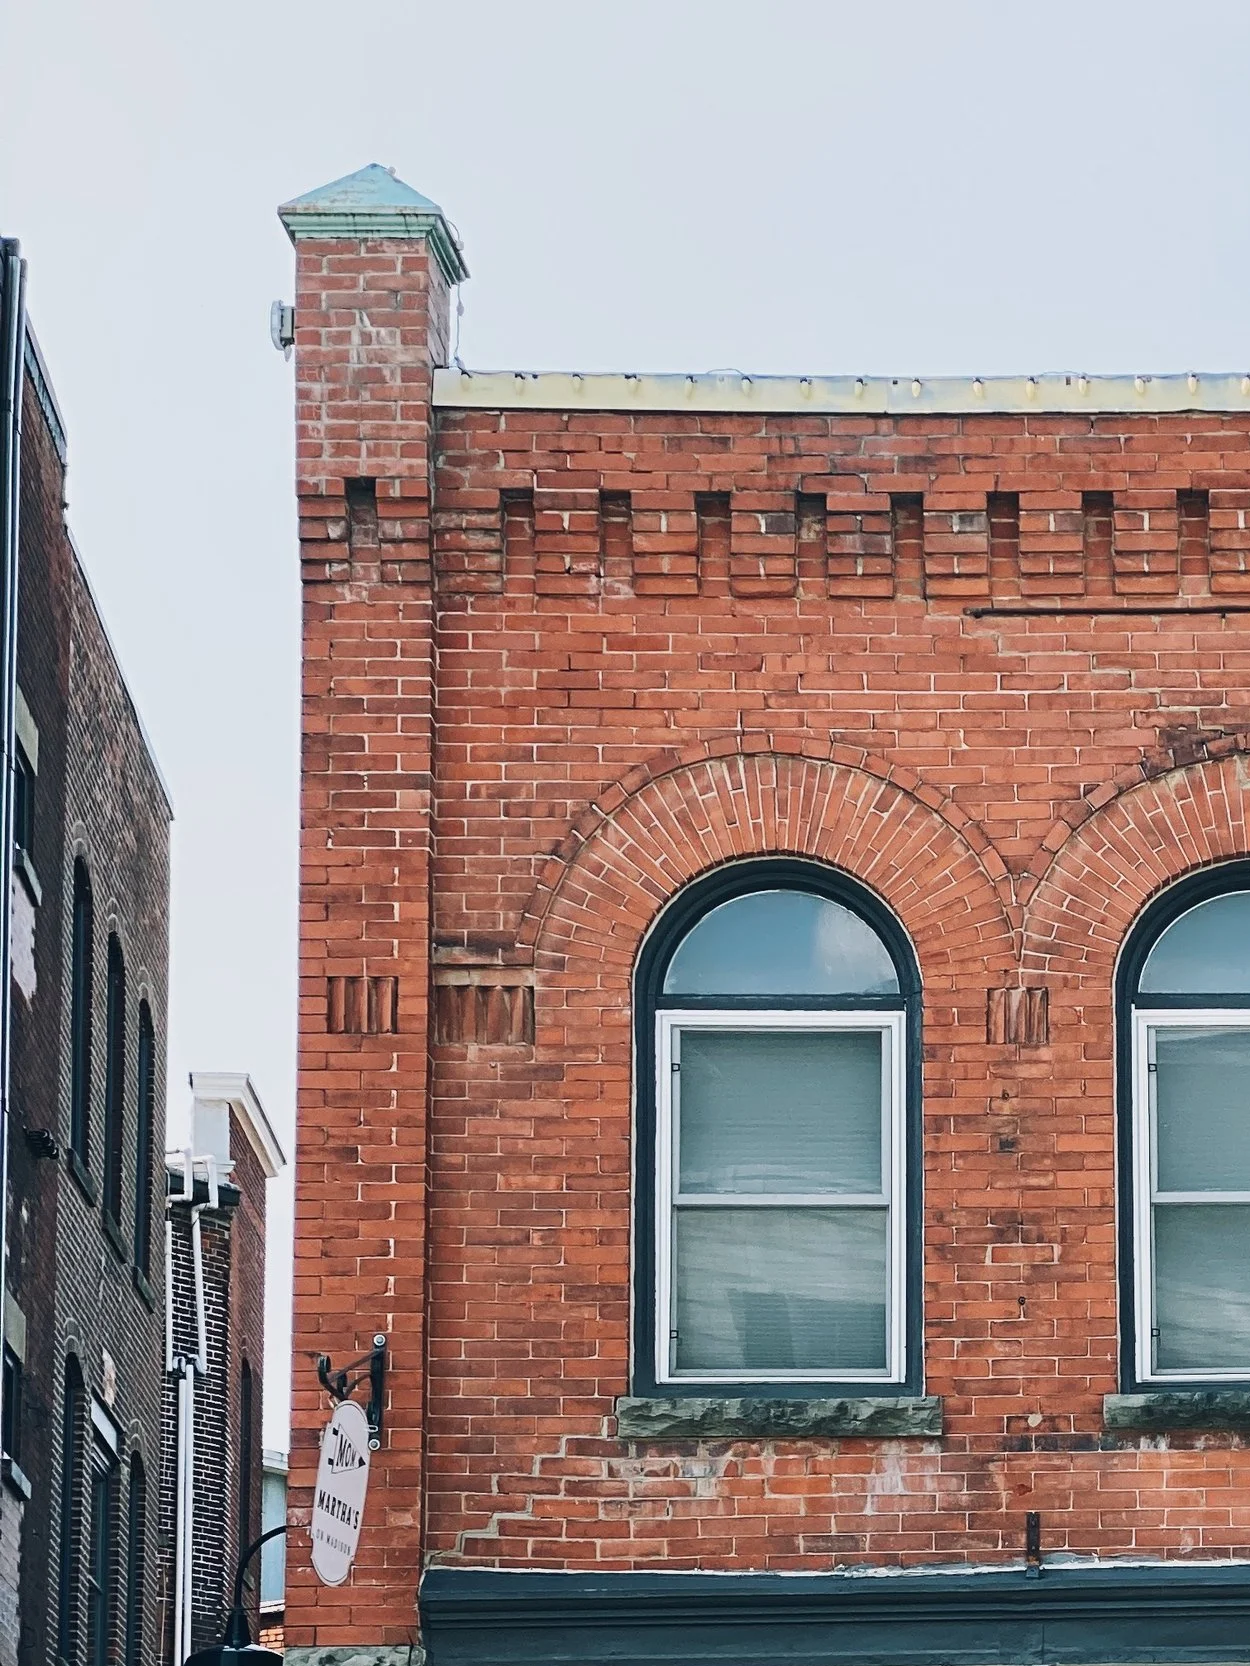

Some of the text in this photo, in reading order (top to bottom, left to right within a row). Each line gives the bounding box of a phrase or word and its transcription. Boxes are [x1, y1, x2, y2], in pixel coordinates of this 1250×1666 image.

[336, 1434, 357, 1467] MOM
[317, 1489, 360, 1530] MARTHA'S
[326, 1533, 352, 1556] MADISON
